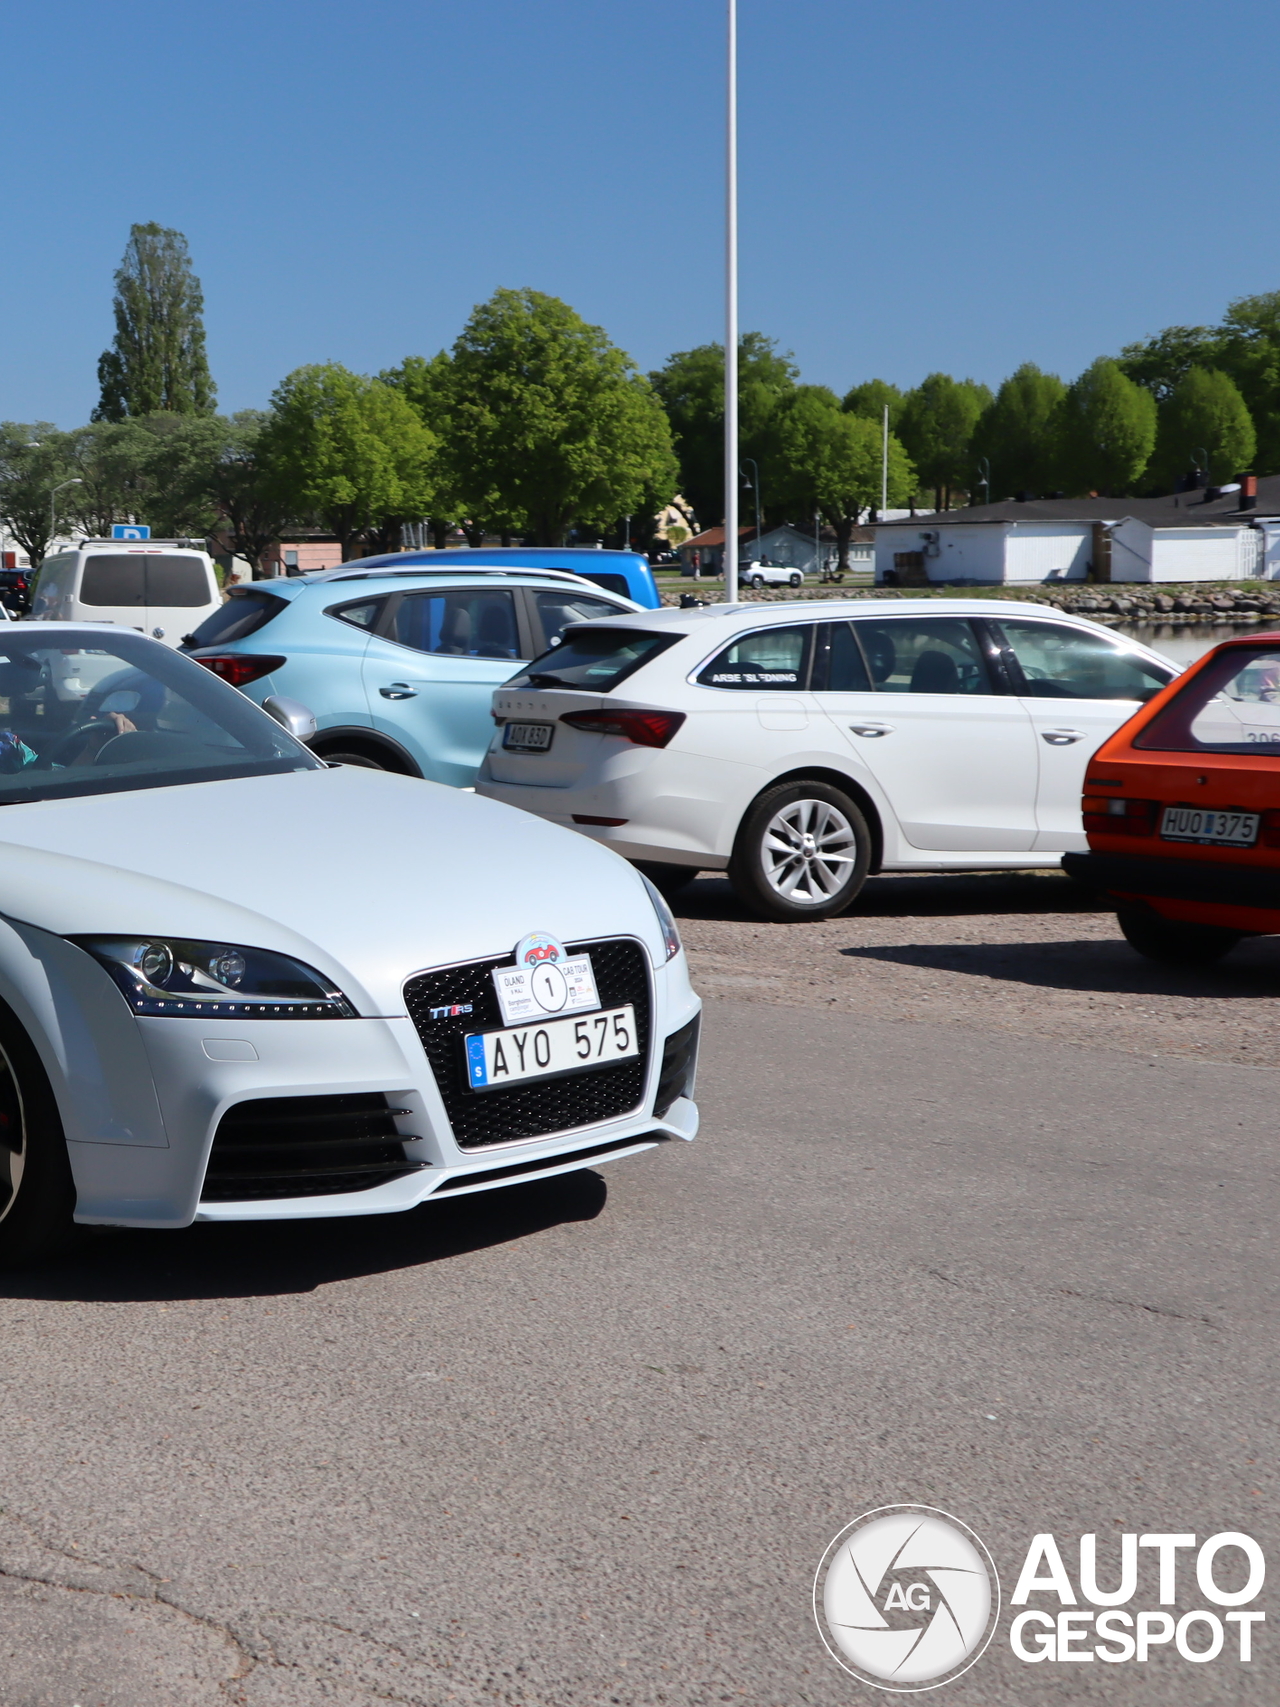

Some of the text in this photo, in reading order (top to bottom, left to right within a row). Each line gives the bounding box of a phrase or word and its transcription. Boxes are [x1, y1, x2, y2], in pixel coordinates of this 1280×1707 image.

[1165, 809, 1255, 838] HUO 375
[562, 964, 588, 976] CAB TOUR
[545, 977, 554, 997] 1
[474, 1013, 630, 1077] S AYO 575
